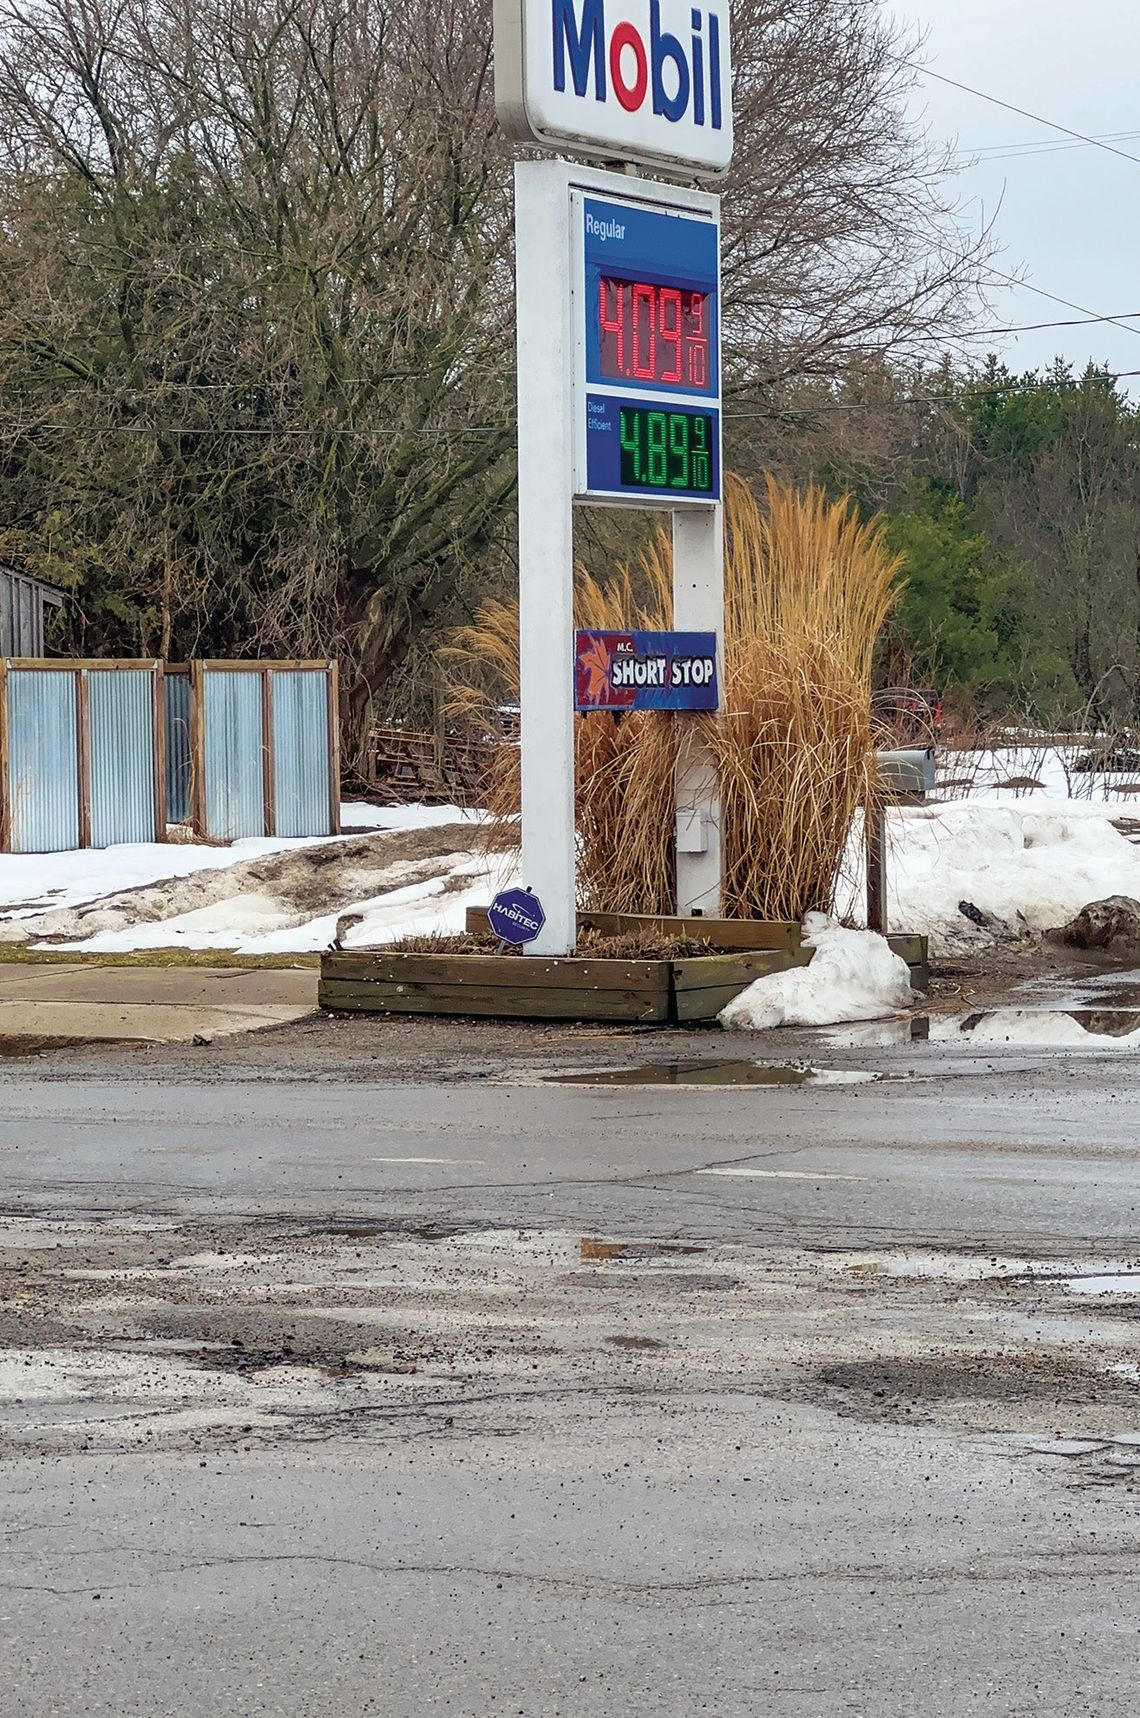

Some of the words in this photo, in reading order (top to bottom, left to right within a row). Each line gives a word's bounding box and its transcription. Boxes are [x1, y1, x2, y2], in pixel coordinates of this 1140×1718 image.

[552, 0, 722, 129] Mobil
[586, 213, 626, 241] Regular
[588, 401, 605, 413] Diesel
[620, 411, 688, 486] 4.89
[616, 642, 633, 652] M.C.
[612, 658, 666, 685] SHORT
[671, 658, 713, 684] STOP
